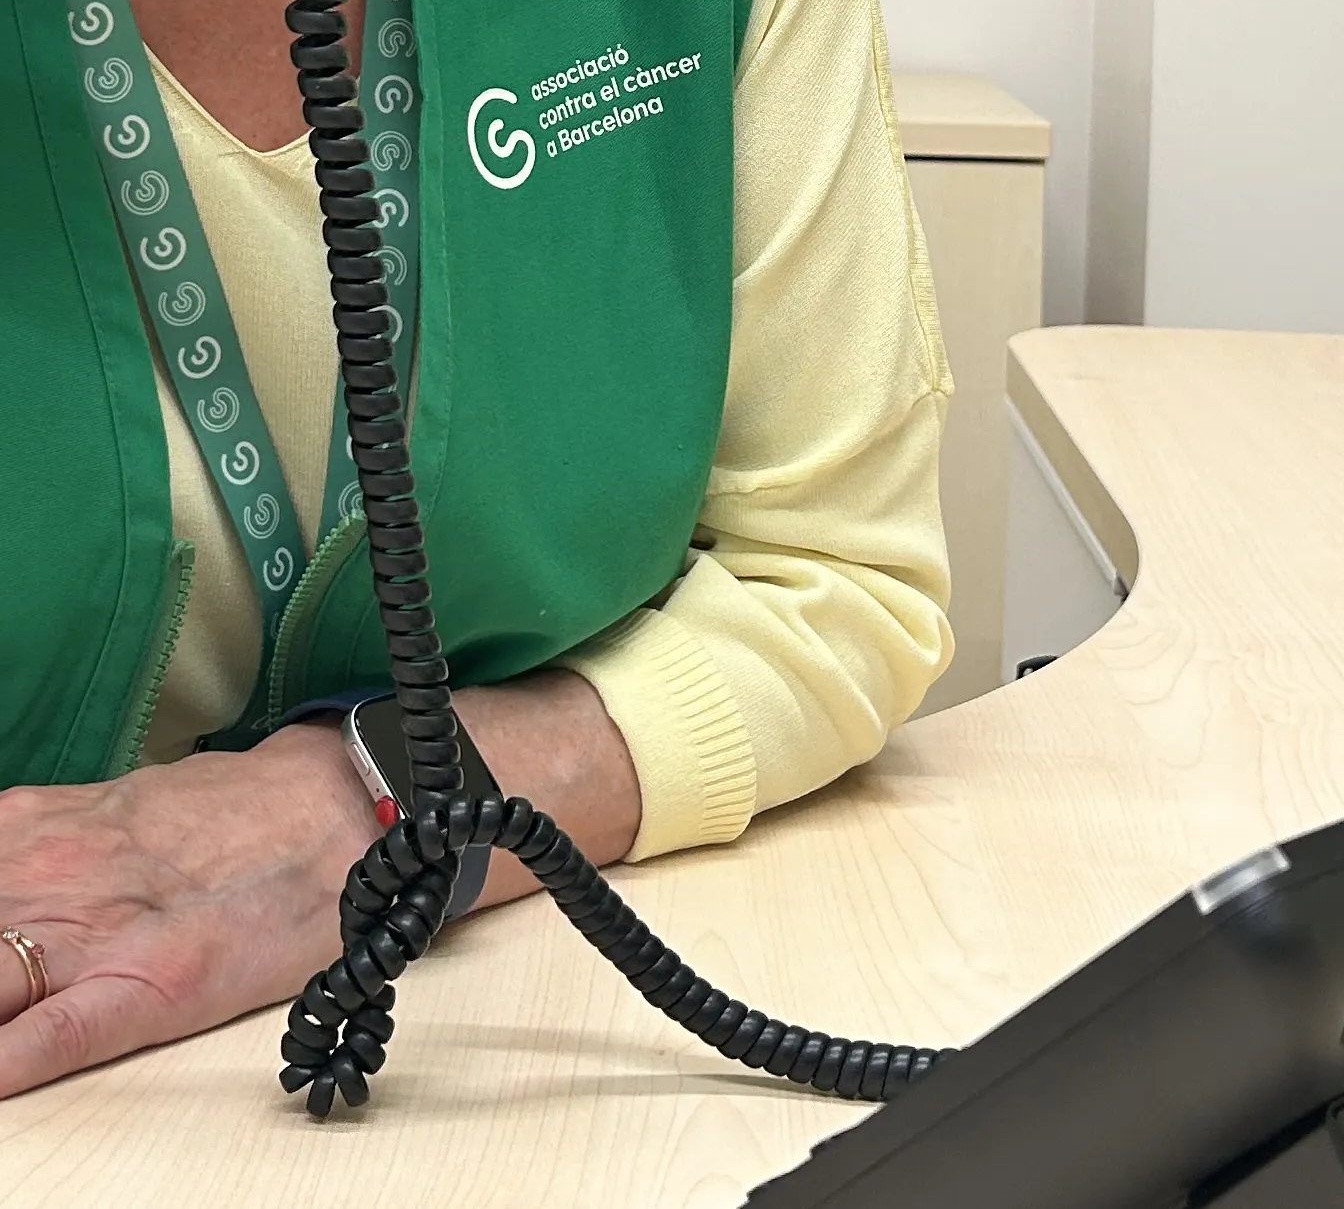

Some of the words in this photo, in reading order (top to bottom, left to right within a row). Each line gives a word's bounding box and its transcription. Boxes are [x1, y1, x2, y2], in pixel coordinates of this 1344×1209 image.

[531, 43, 630, 101] associació
[538, 91, 598, 130] contra
[600, 76, 621, 102] el
[623, 52, 702, 93] càncer
[546, 140, 558, 158] a
[557, 96, 664, 152] Barcelona
